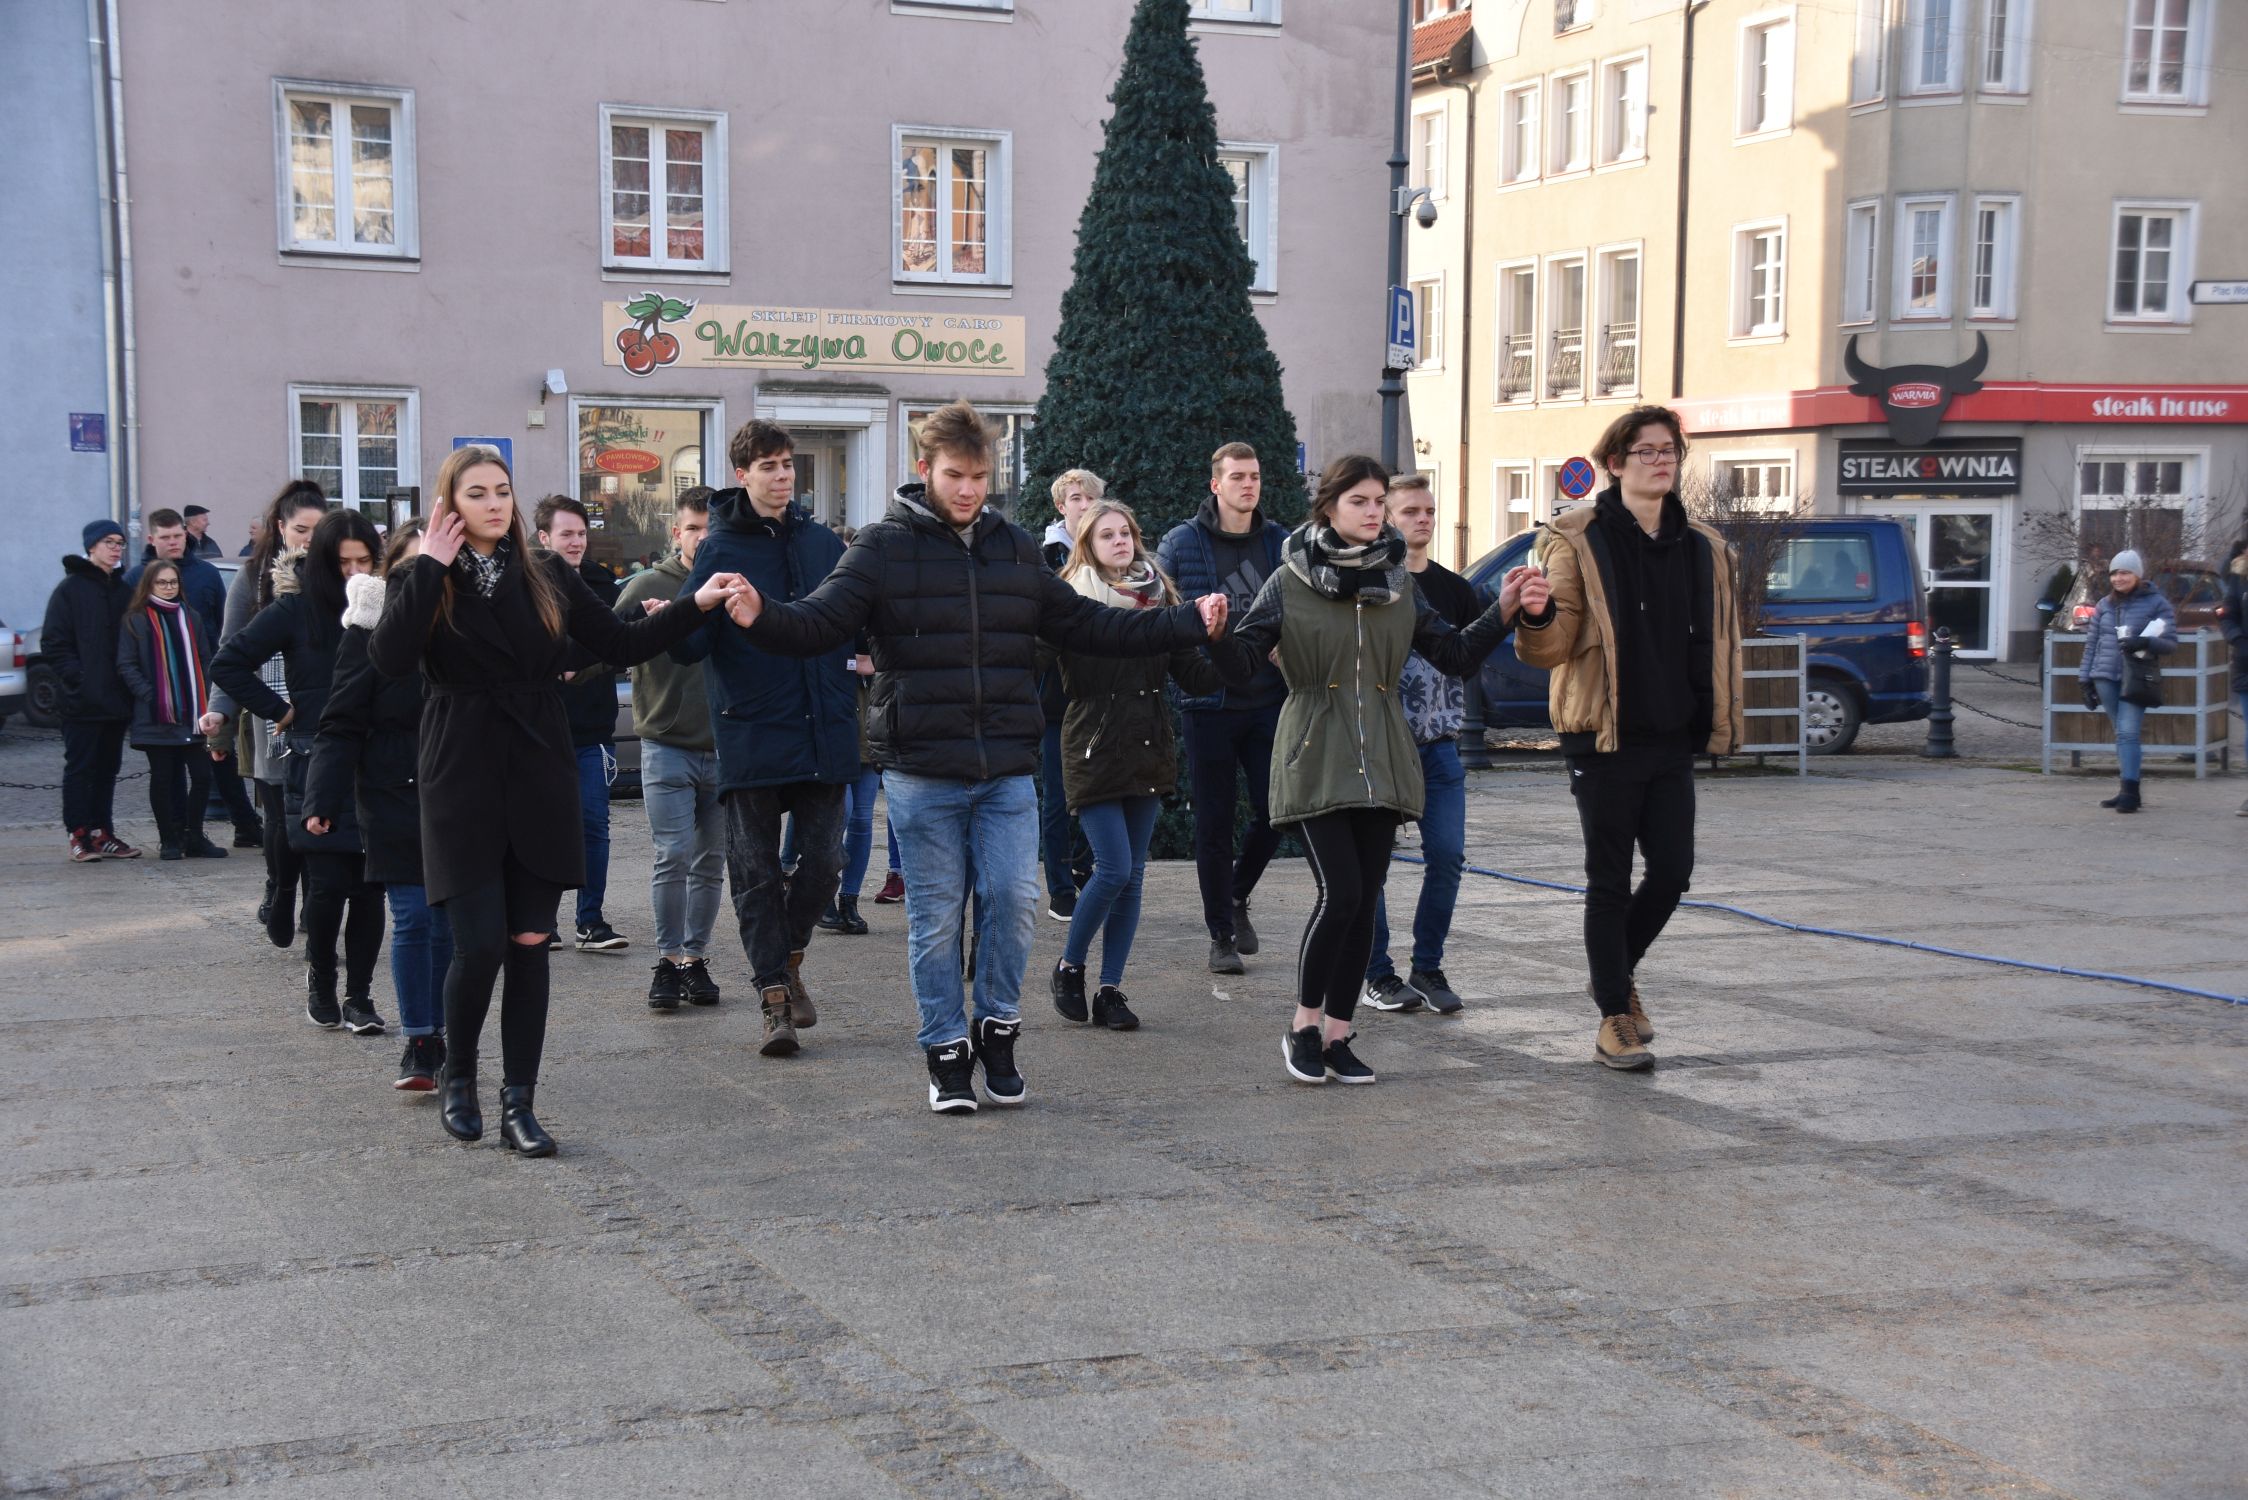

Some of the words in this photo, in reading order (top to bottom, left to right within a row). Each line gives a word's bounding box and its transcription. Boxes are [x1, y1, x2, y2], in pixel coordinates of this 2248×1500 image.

[752, 311, 818, 323] SKLEP
[828, 313, 933, 327] FIRMOWY
[944, 318, 1003, 330] CARO
[1396, 294, 1411, 344] P
[695, 319, 867, 369] Warzywa
[892, 329, 1007, 364] Owoce
[1892, 390, 1936, 401] WARMIA
[2092, 396, 2155, 417] steak
[2160, 396, 2228, 417] house
[1842, 456, 2014, 478] STEAKOWNIA
[940, 1053, 956, 1061] PUMA
